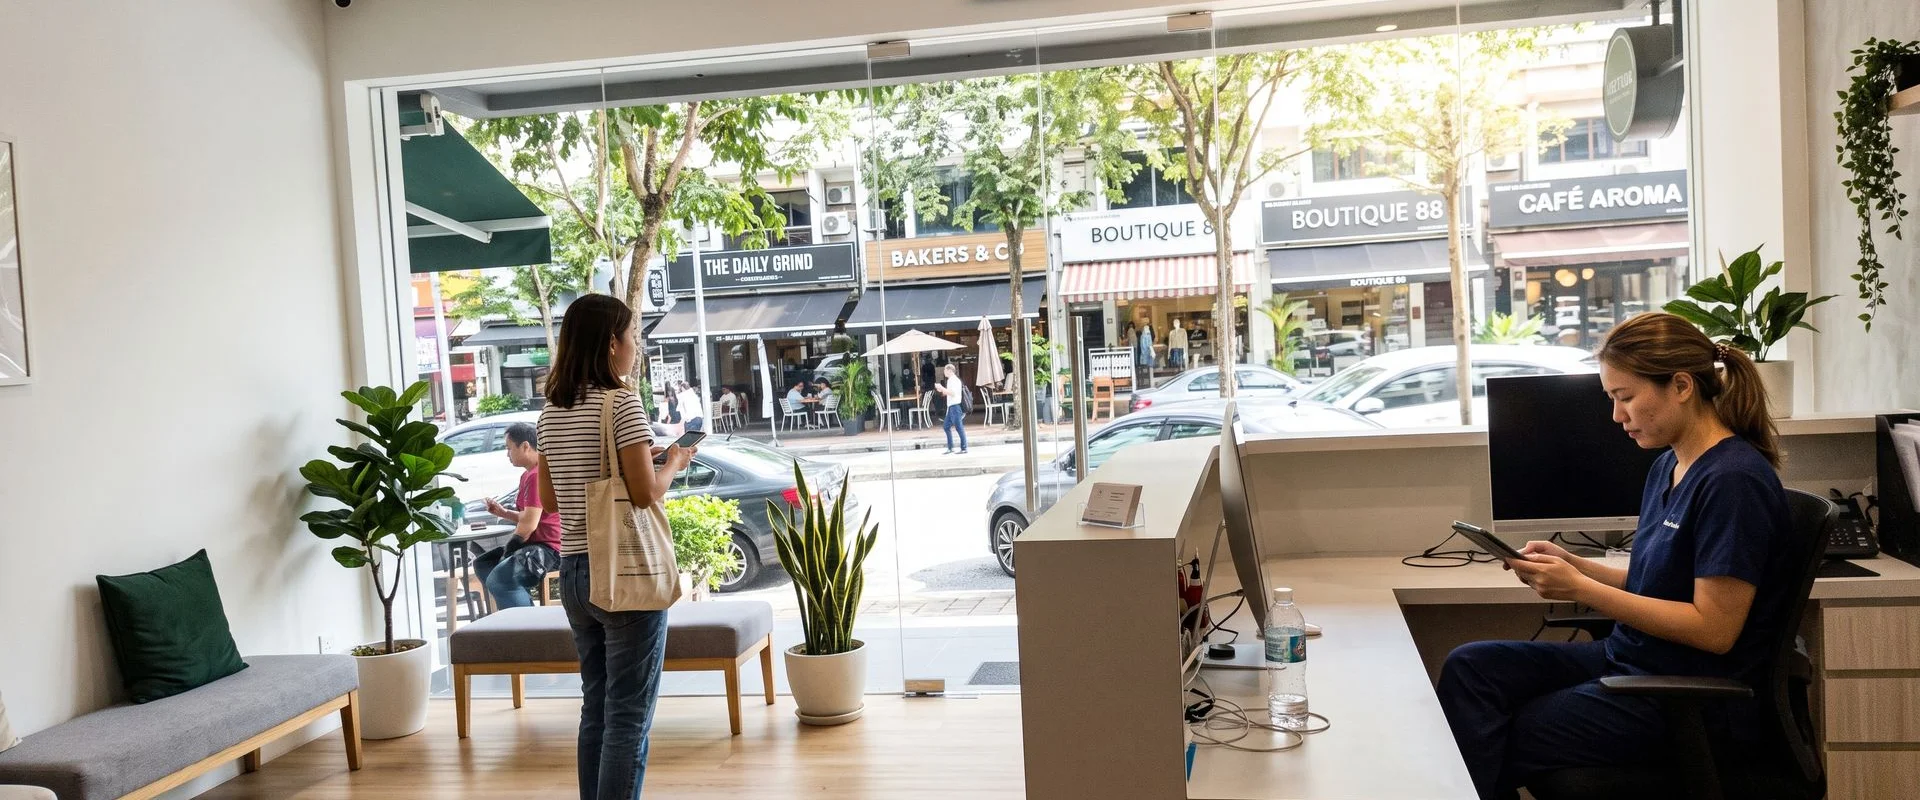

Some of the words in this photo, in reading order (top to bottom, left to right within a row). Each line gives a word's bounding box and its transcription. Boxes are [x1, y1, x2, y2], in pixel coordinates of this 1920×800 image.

[1519, 185, 1584, 213] CAFÉ
[1590, 183, 1682, 208] AROMA
[1292, 202, 1409, 230] BOUTIQUE
[1415, 199, 1444, 220] 88
[1092, 221, 1195, 243] BOUTIQUE
[703, 258, 730, 276] THE
[732, 256, 769, 274] DAILY
[772, 253, 813, 272] GRIND
[891, 245, 969, 268] BAKERS
[975, 245, 989, 262] &
[995, 243, 1024, 260] C
[1350, 277, 1394, 287] BOUTIQUE
